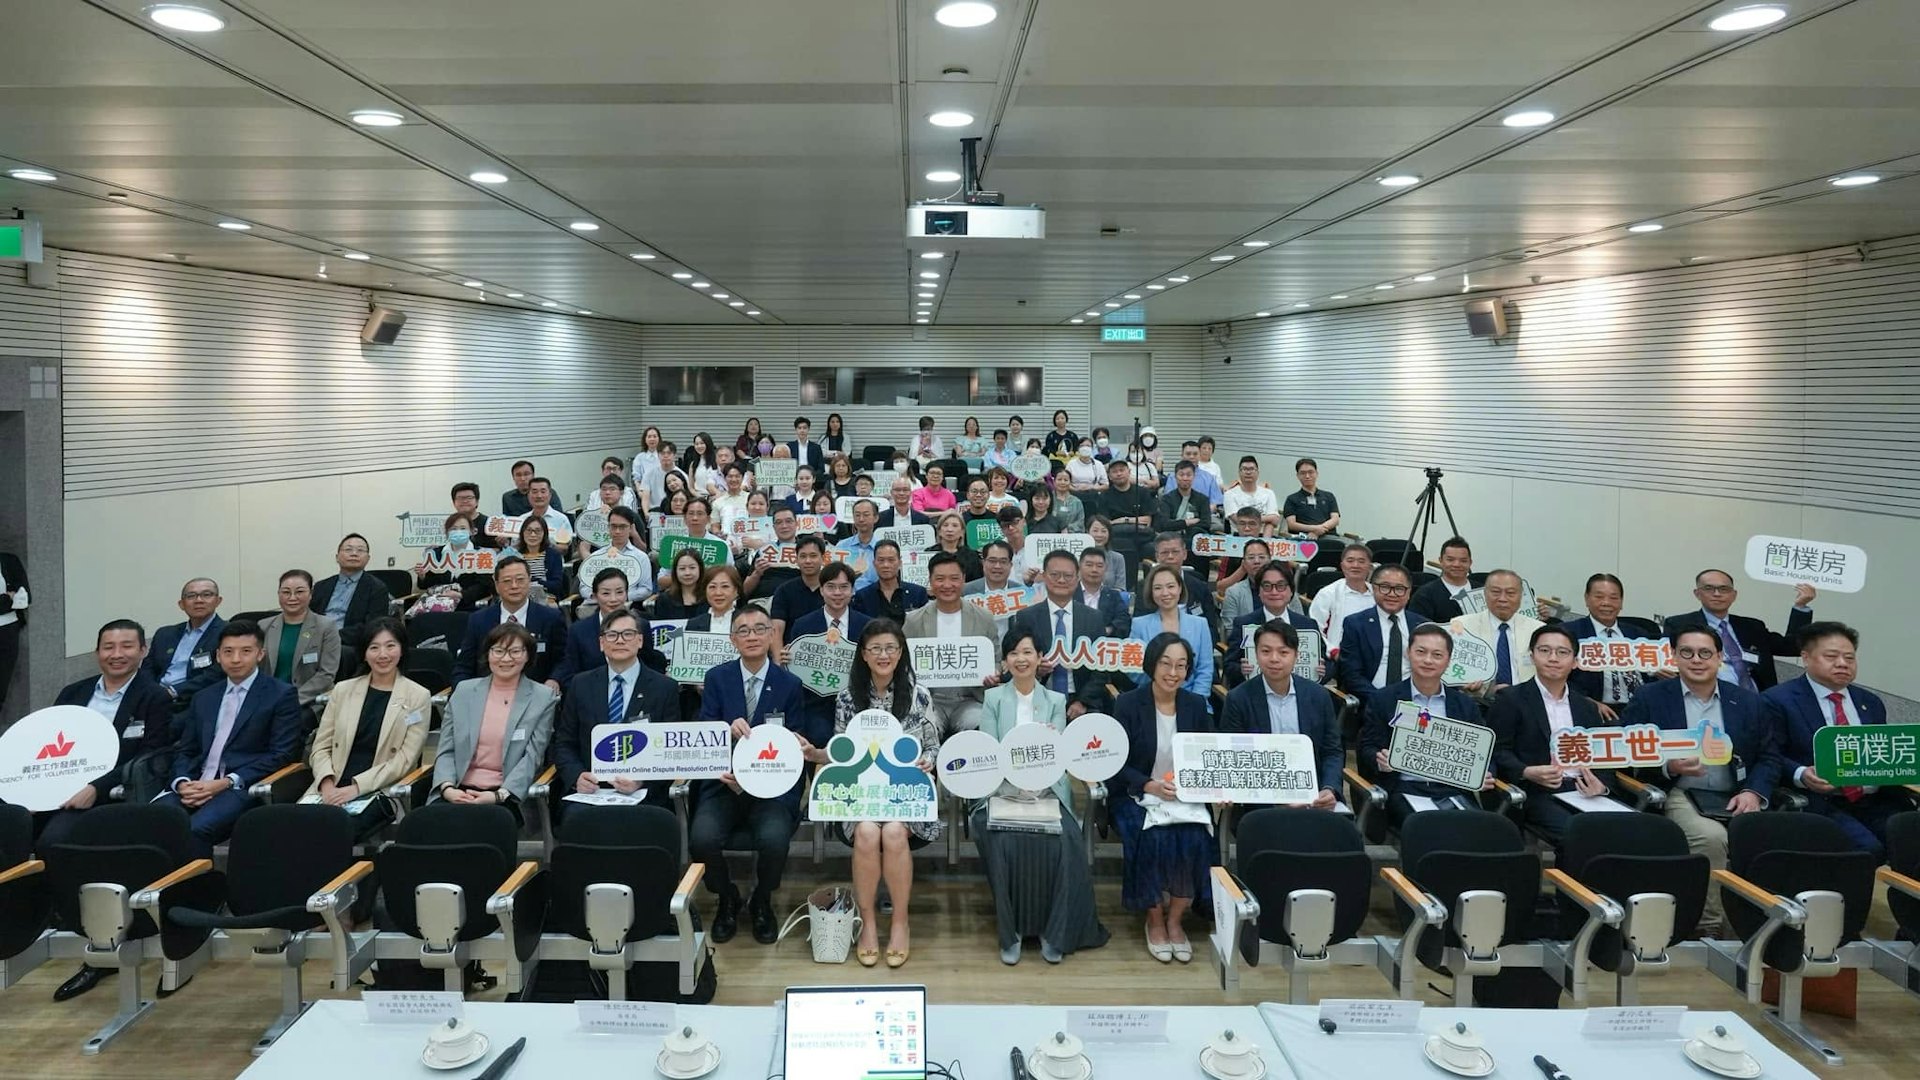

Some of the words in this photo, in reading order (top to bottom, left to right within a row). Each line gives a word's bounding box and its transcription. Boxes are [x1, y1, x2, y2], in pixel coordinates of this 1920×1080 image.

[1104, 328, 1126, 340] EXIT
[976, 523, 1005, 540] 簡樸
[423, 552, 494, 570] 人人行義
[1765, 542, 1846, 576] 簡樸房
[1764, 568, 1785, 577] Basic
[1787, 571, 1819, 582] Housing
[1821, 575, 1843, 584] Units
[914, 644, 979, 671] 簡樸房
[1048, 640, 1143, 667] 人人行義
[811, 670, 841, 689] 全免
[933, 673, 960, 682] Housing
[961, 672, 979, 680] Units
[653, 730, 728, 749] eBRAM
[1430, 721, 1480, 749] 簡樸房
[1010, 743, 1055, 766] 簡樸房
[1405, 734, 1477, 767] 登記改造
[1557, 729, 1695, 764] 義工世一
[1833, 732, 1917, 766] 簡樸房
[22, 758, 88, 774] 義務工作發展局
[652, 766, 675, 774] Dispute
[1202, 750, 1287, 770] 簡樸房制度
[1401, 752, 1471, 784] 依法出租
[1179, 769, 1313, 790] 義務調解服務計劃
[1837, 768, 1860, 777] Basic
[1861, 769, 1894, 778] Housing
[1895, 767, 1917, 776] Units
